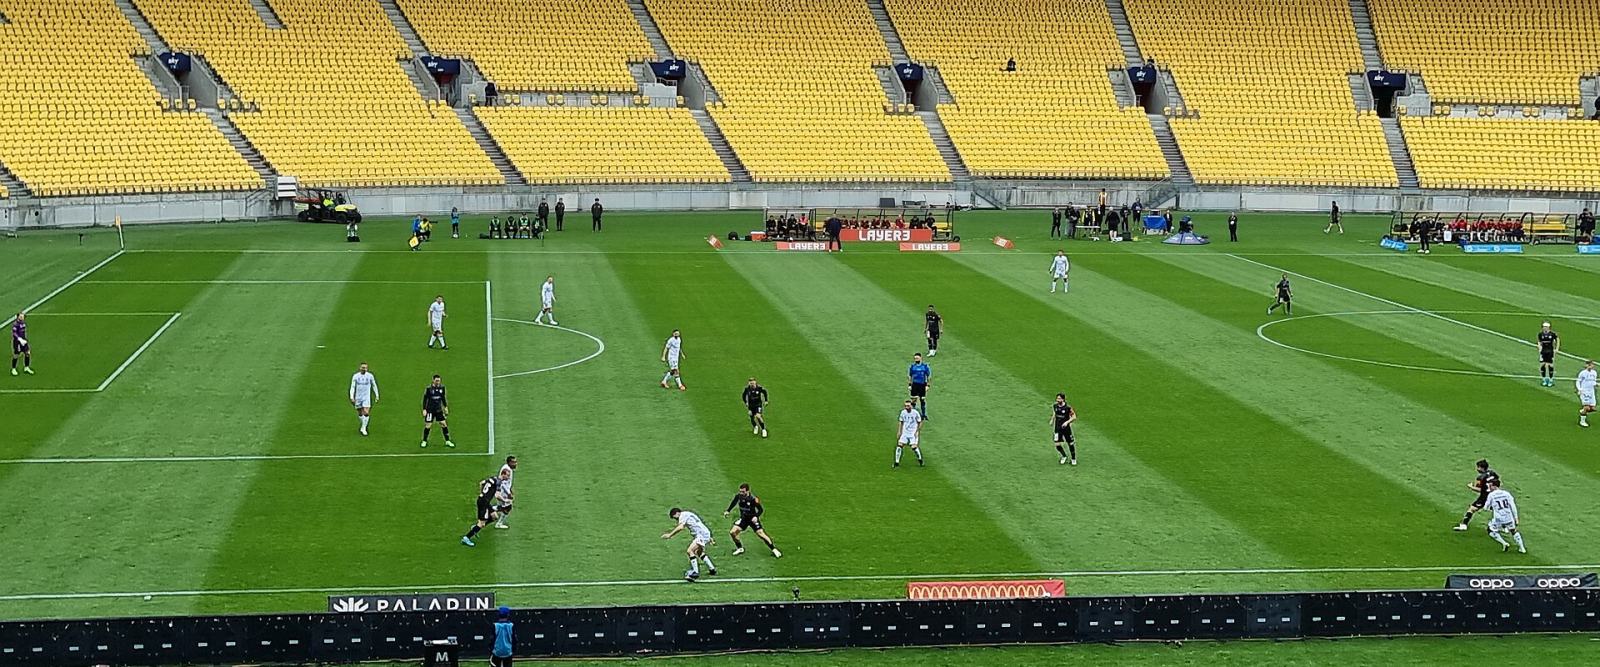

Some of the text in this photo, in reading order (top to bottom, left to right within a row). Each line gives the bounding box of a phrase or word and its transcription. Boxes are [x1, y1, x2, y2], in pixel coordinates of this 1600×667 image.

[859, 229, 910, 241] LAYER3
[1469, 578, 1514, 589] oppo
[1537, 577, 1581, 588] oppo
[377, 597, 489, 611] PALADIN
[436, 652, 449, 662] M
